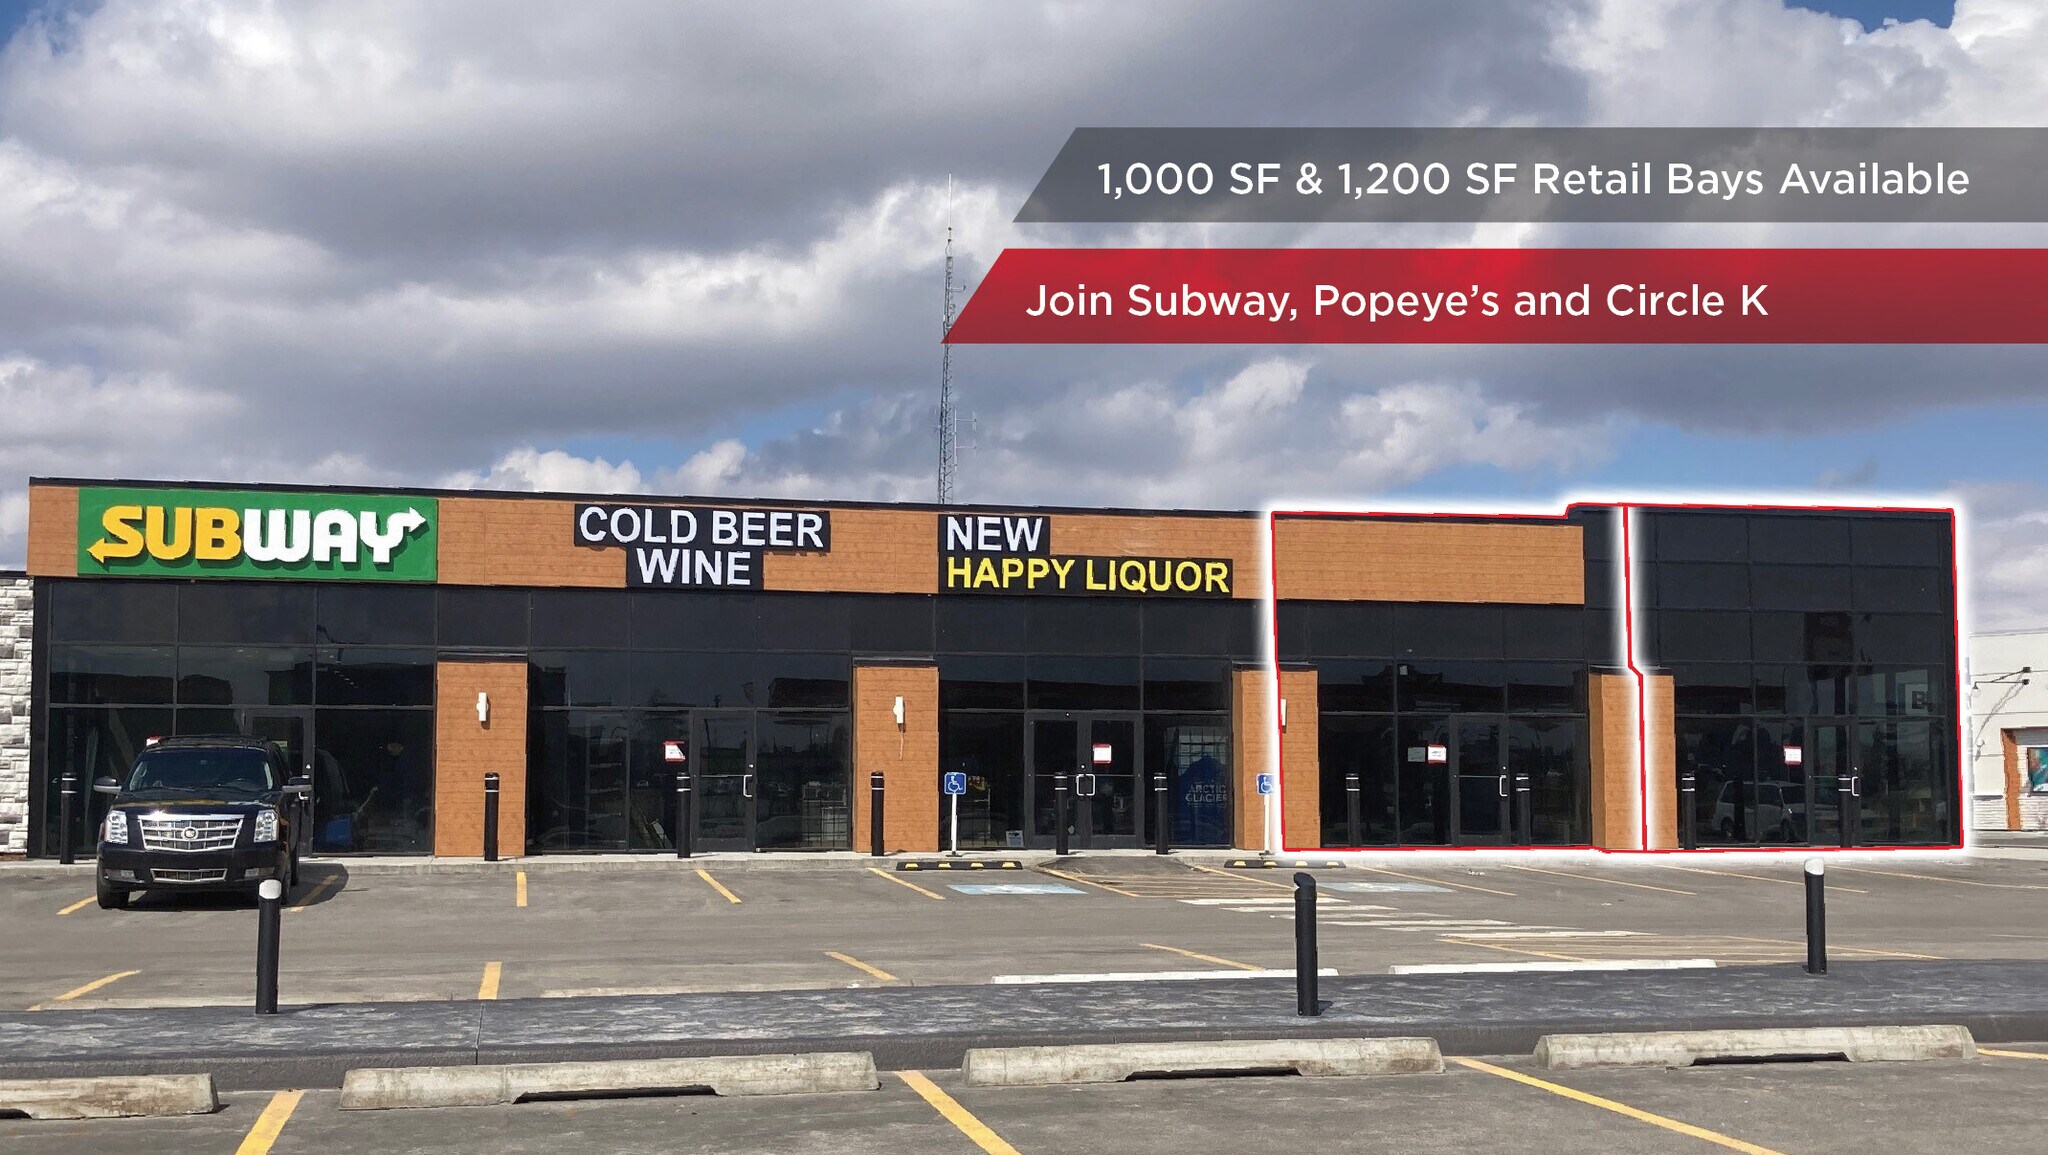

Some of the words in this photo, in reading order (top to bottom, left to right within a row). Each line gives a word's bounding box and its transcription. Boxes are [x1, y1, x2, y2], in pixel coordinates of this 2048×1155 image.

[87, 505, 426, 564] SUBWAY
[579, 505, 698, 545] COLD
[711, 509, 823, 549] BEER
[946, 516, 1044, 552] NEW
[636, 548, 752, 586] WINE
[947, 556, 1075, 590] HAPPY
[1086, 559, 1229, 594] LIQUOR
